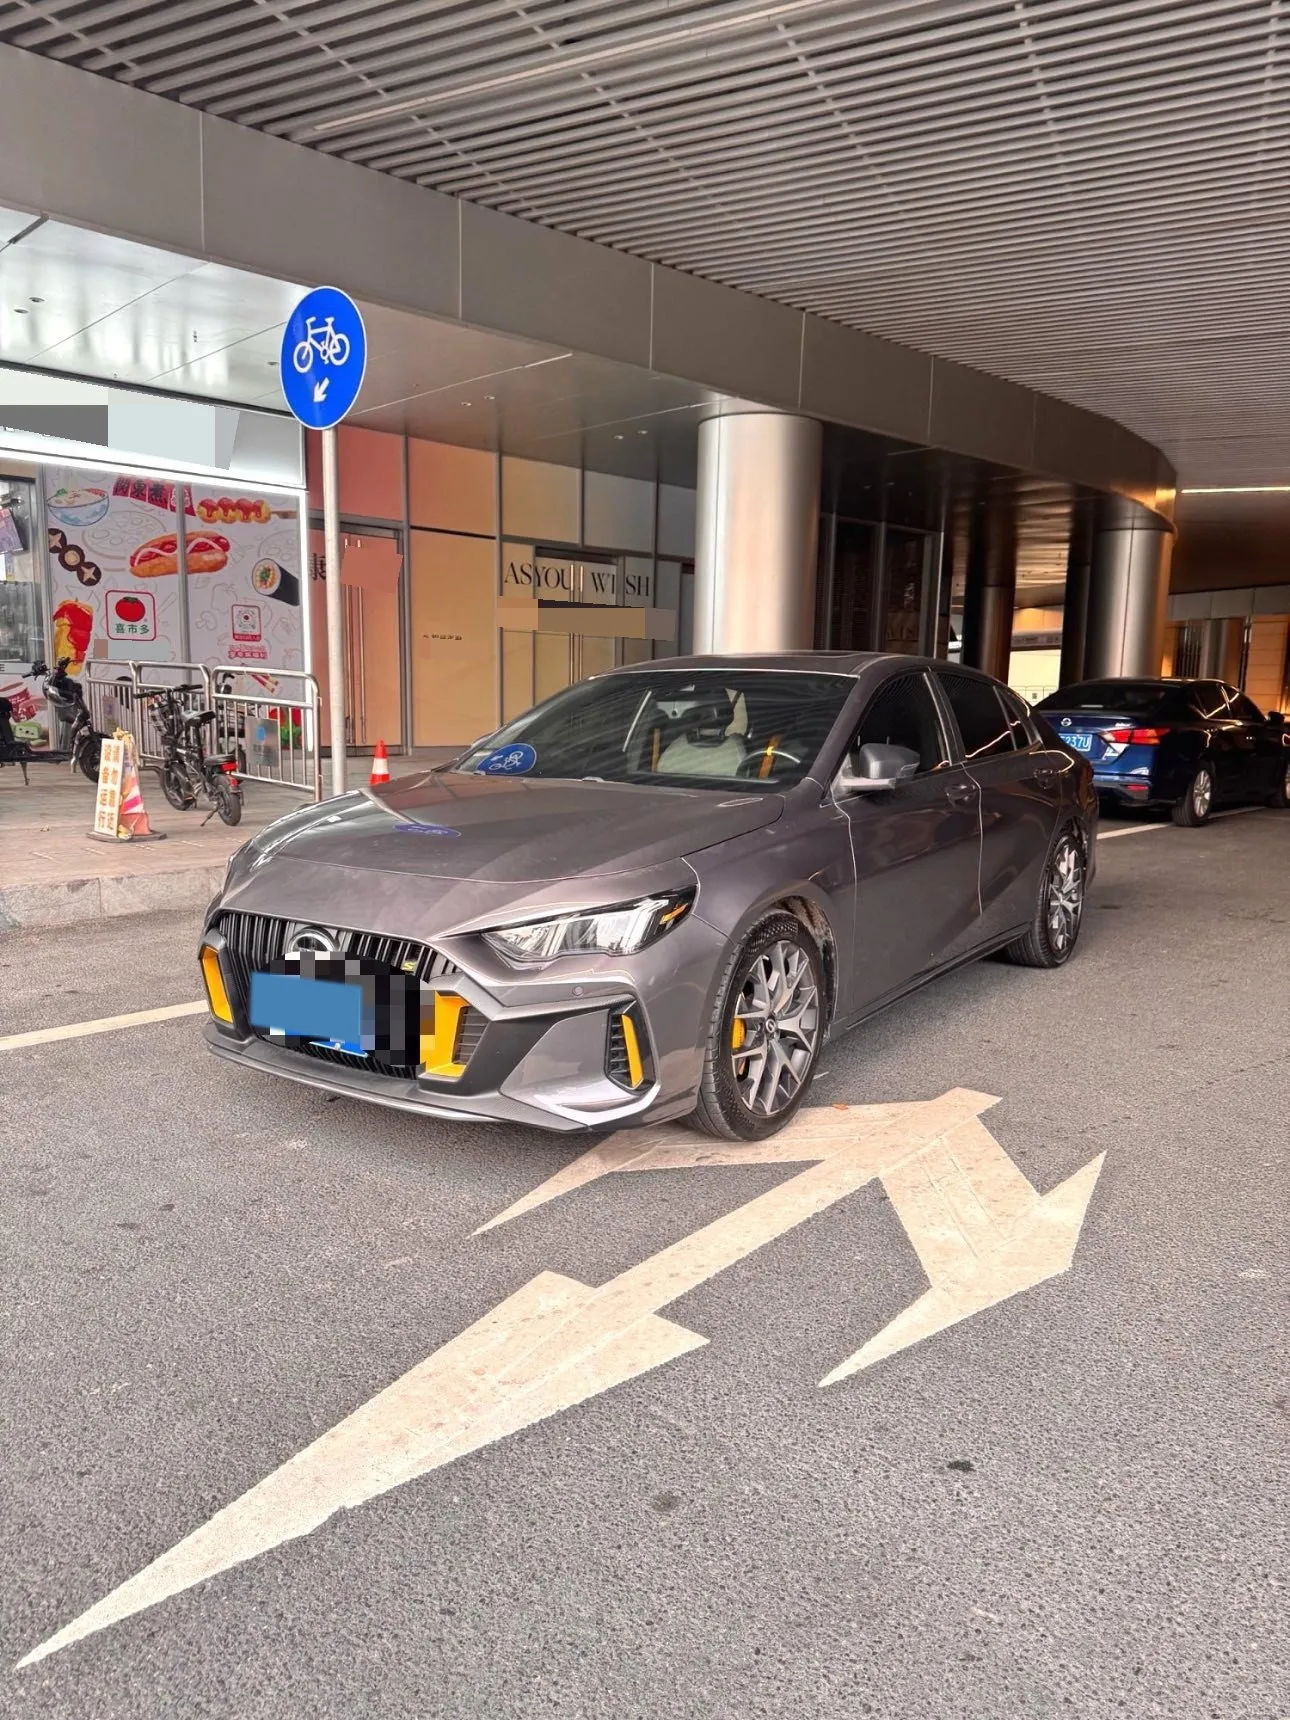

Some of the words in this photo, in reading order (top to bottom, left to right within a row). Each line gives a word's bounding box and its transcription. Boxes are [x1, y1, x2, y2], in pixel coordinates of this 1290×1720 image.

[591, 571, 650, 597] WISH
[115, 623, 149, 634] 喜市多
[1060, 734, 1090, 748] 237U
